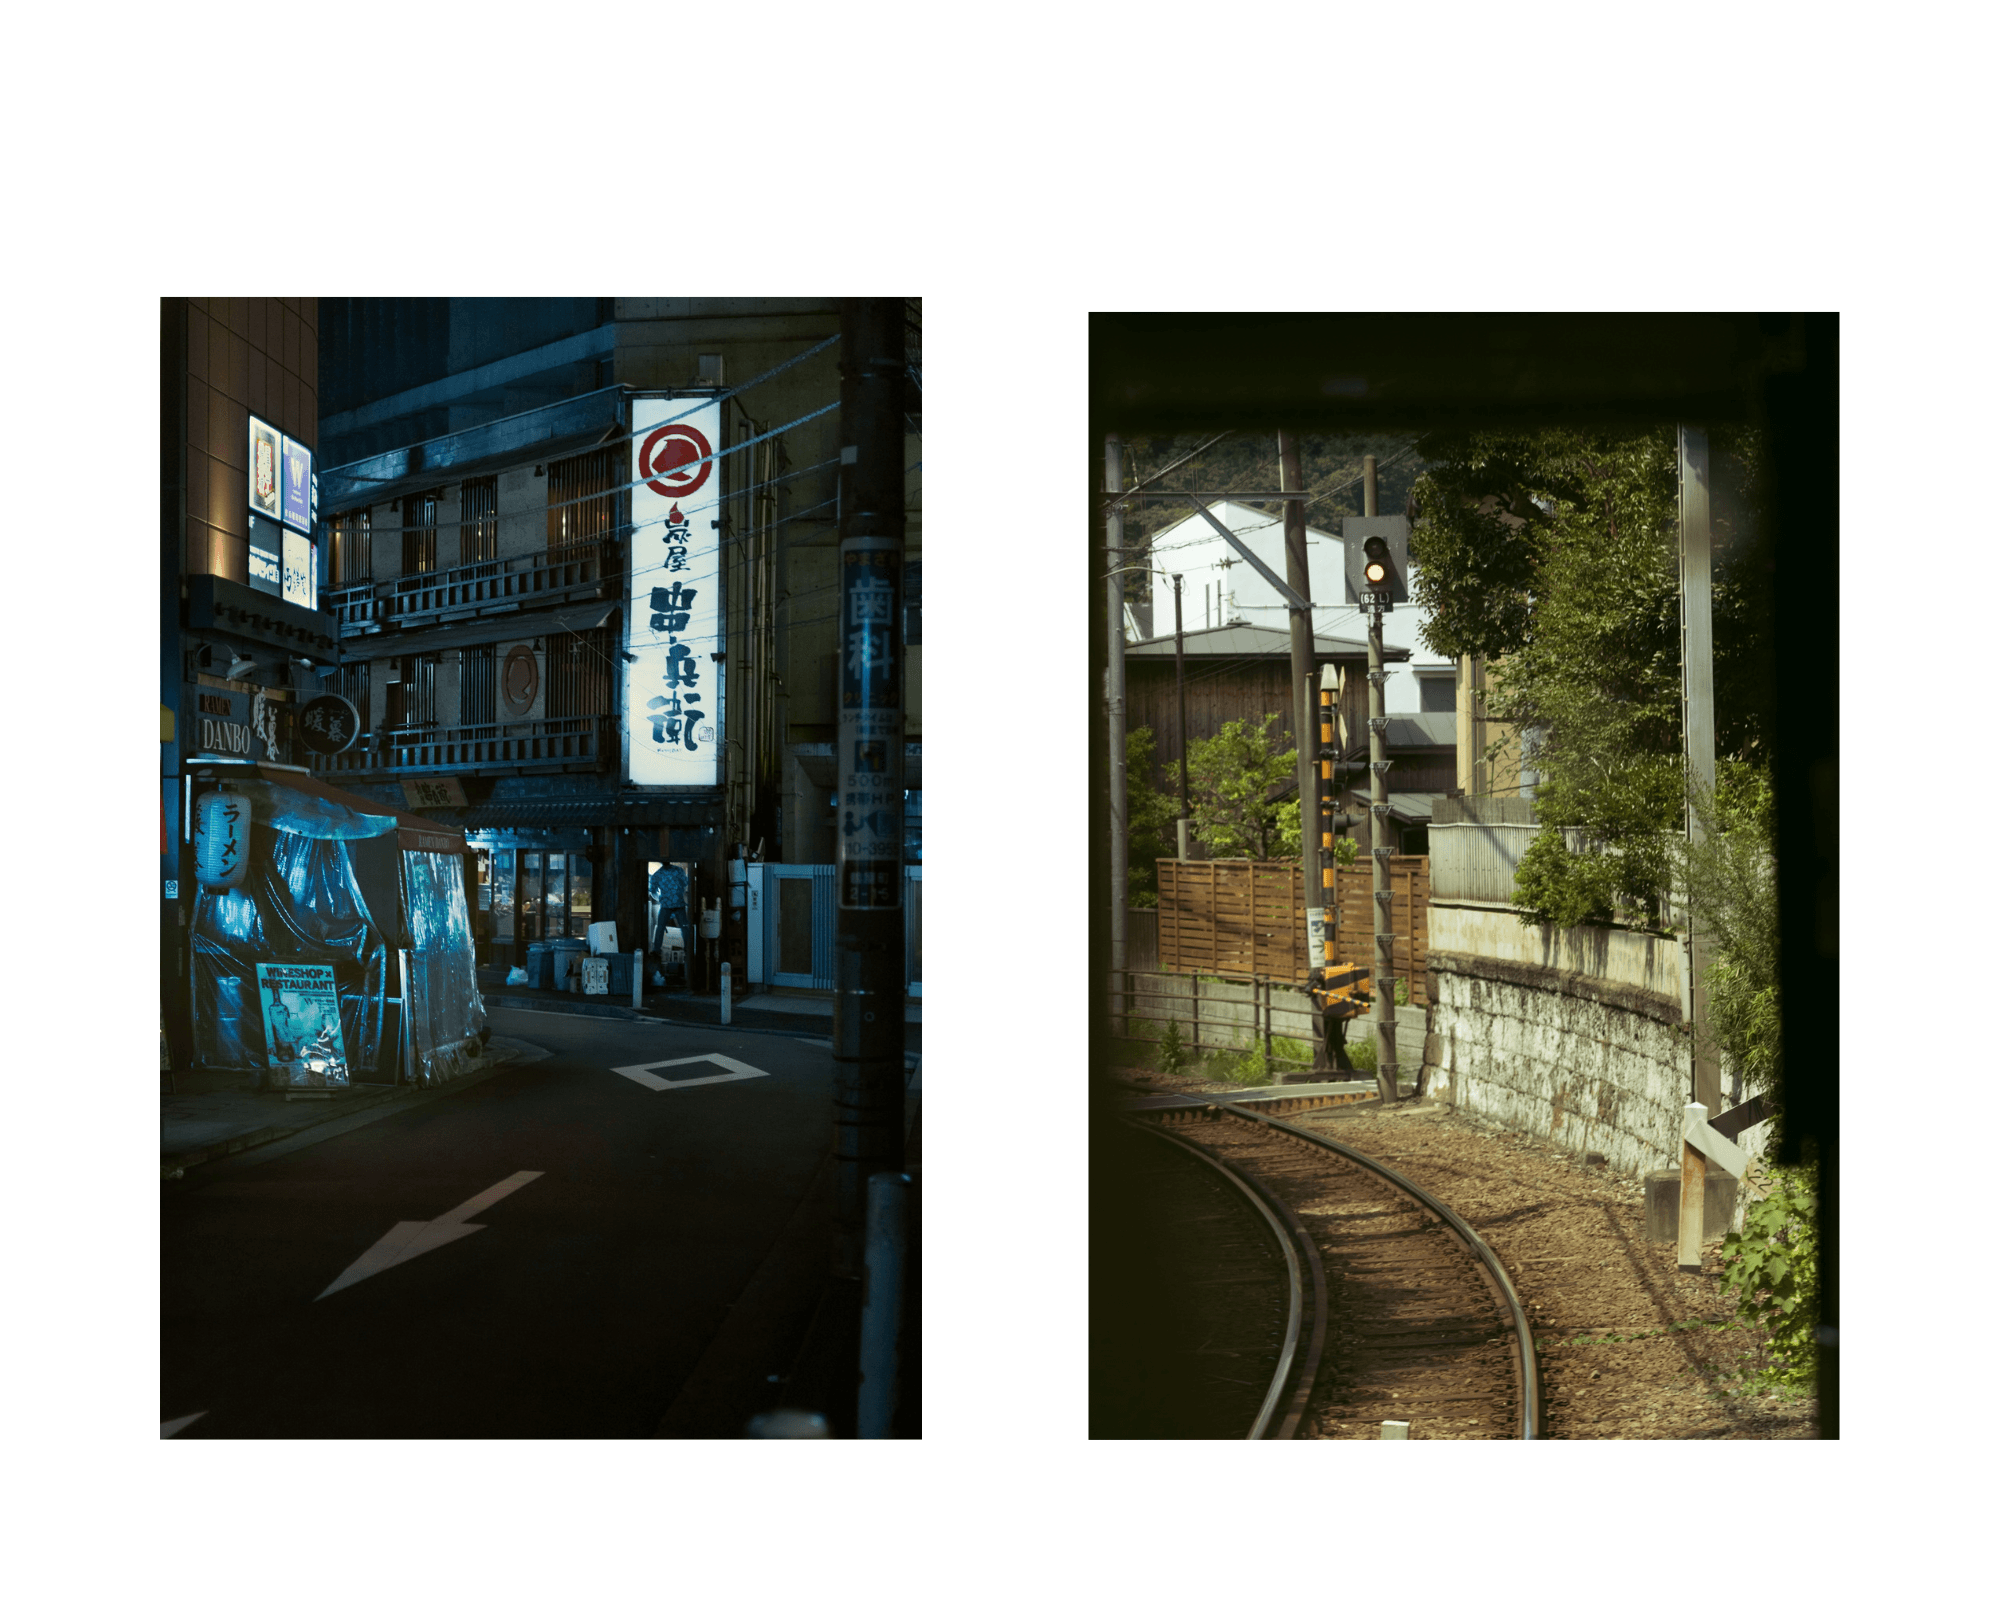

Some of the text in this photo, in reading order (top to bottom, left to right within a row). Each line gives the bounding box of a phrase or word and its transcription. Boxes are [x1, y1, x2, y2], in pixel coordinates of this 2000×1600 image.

[662, 504, 691, 571] 炭屋
[848, 576, 894, 680] 歯科
[646, 582, 706, 752] 串兵衛
[204, 695, 231, 716] RAMEN
[203, 718, 251, 755] DANBO
[220, 804, 240, 878] ラーメン
[261, 978, 335, 990] RESTAURANT
[265, 967, 324, 979] WINESHOP
